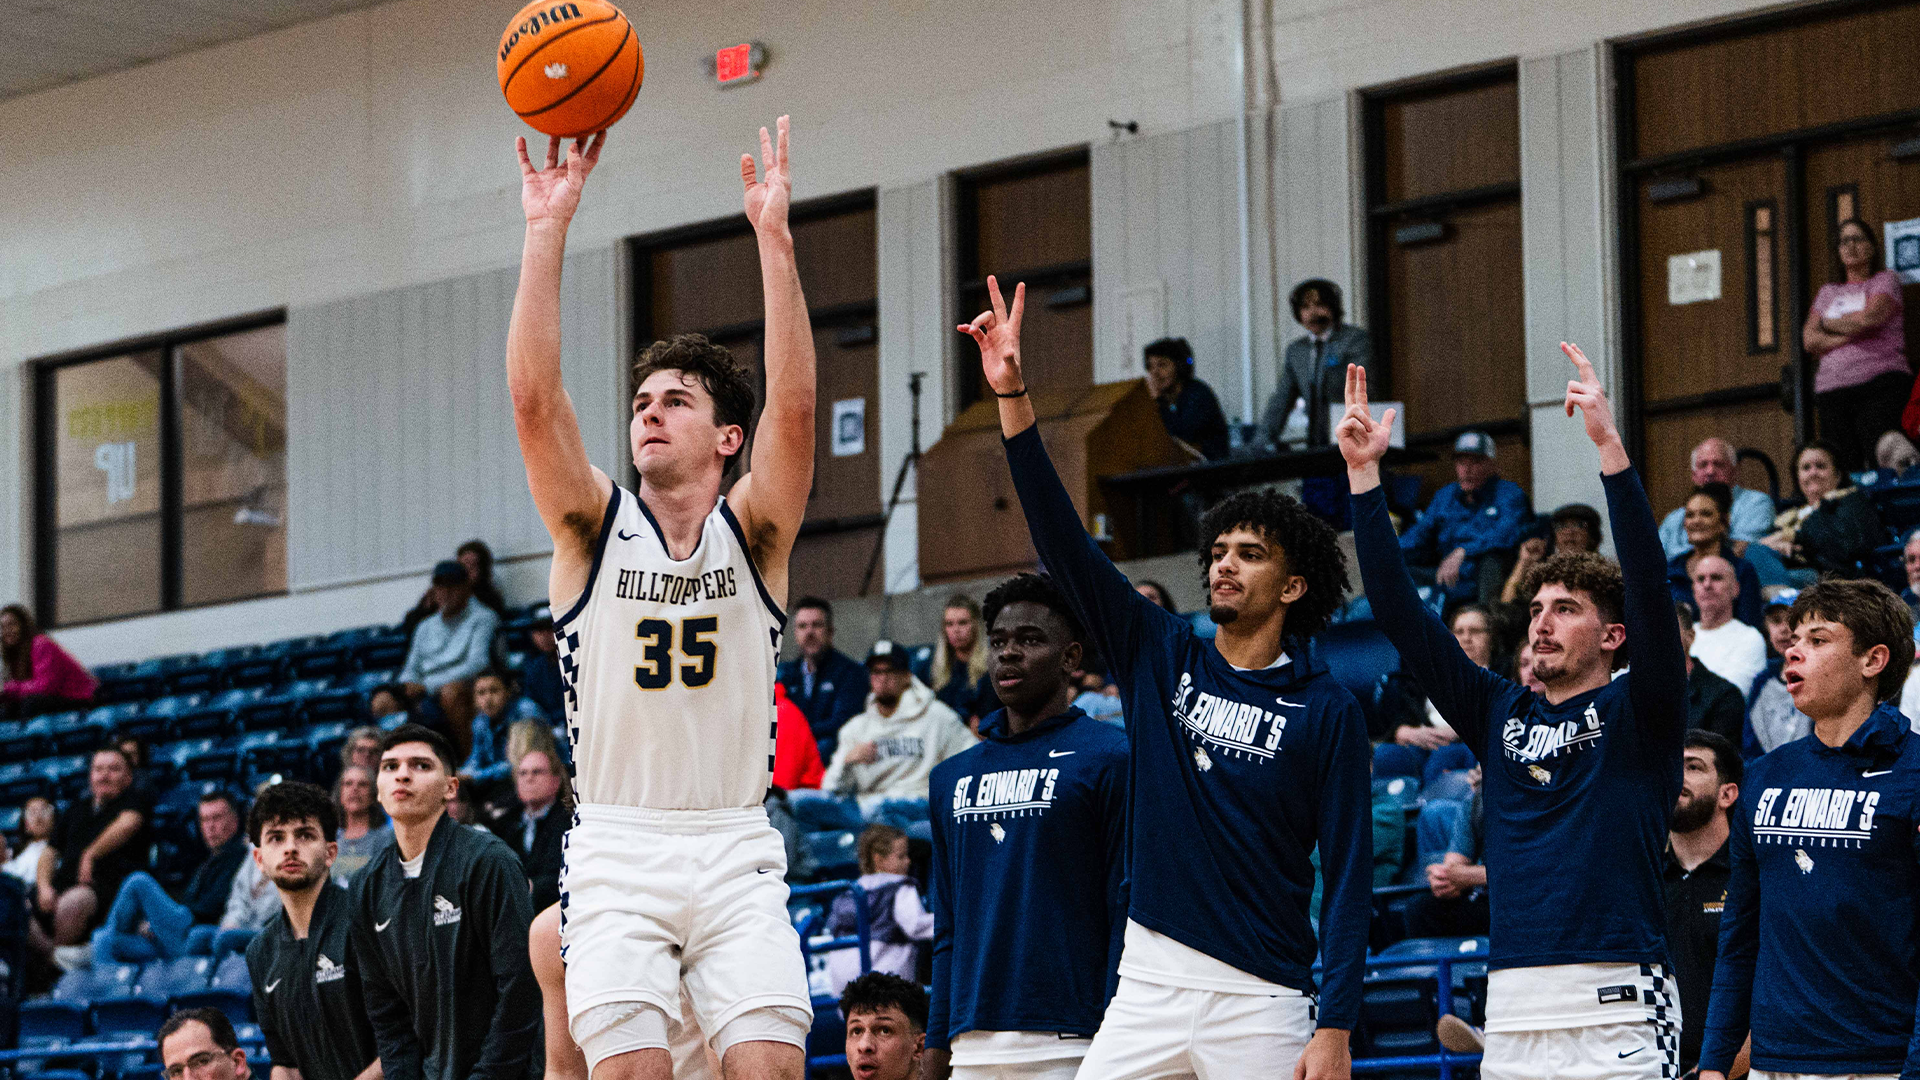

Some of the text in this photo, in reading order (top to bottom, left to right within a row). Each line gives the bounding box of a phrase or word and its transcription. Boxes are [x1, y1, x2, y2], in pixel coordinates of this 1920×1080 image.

[501, 3, 583, 61] Wilson
[616, 567, 737, 606] HILLTOPPERS
[633, 614, 719, 692] 35
[1187, 691, 1287, 751] EDWARD'S
[952, 768, 1060, 810] ST. EDWARD'S
[1754, 787, 1881, 831] ST. EDWARD'S
[957, 808, 1043, 824] BASKETBALL
[1757, 834, 1862, 849] BASKETBALL
